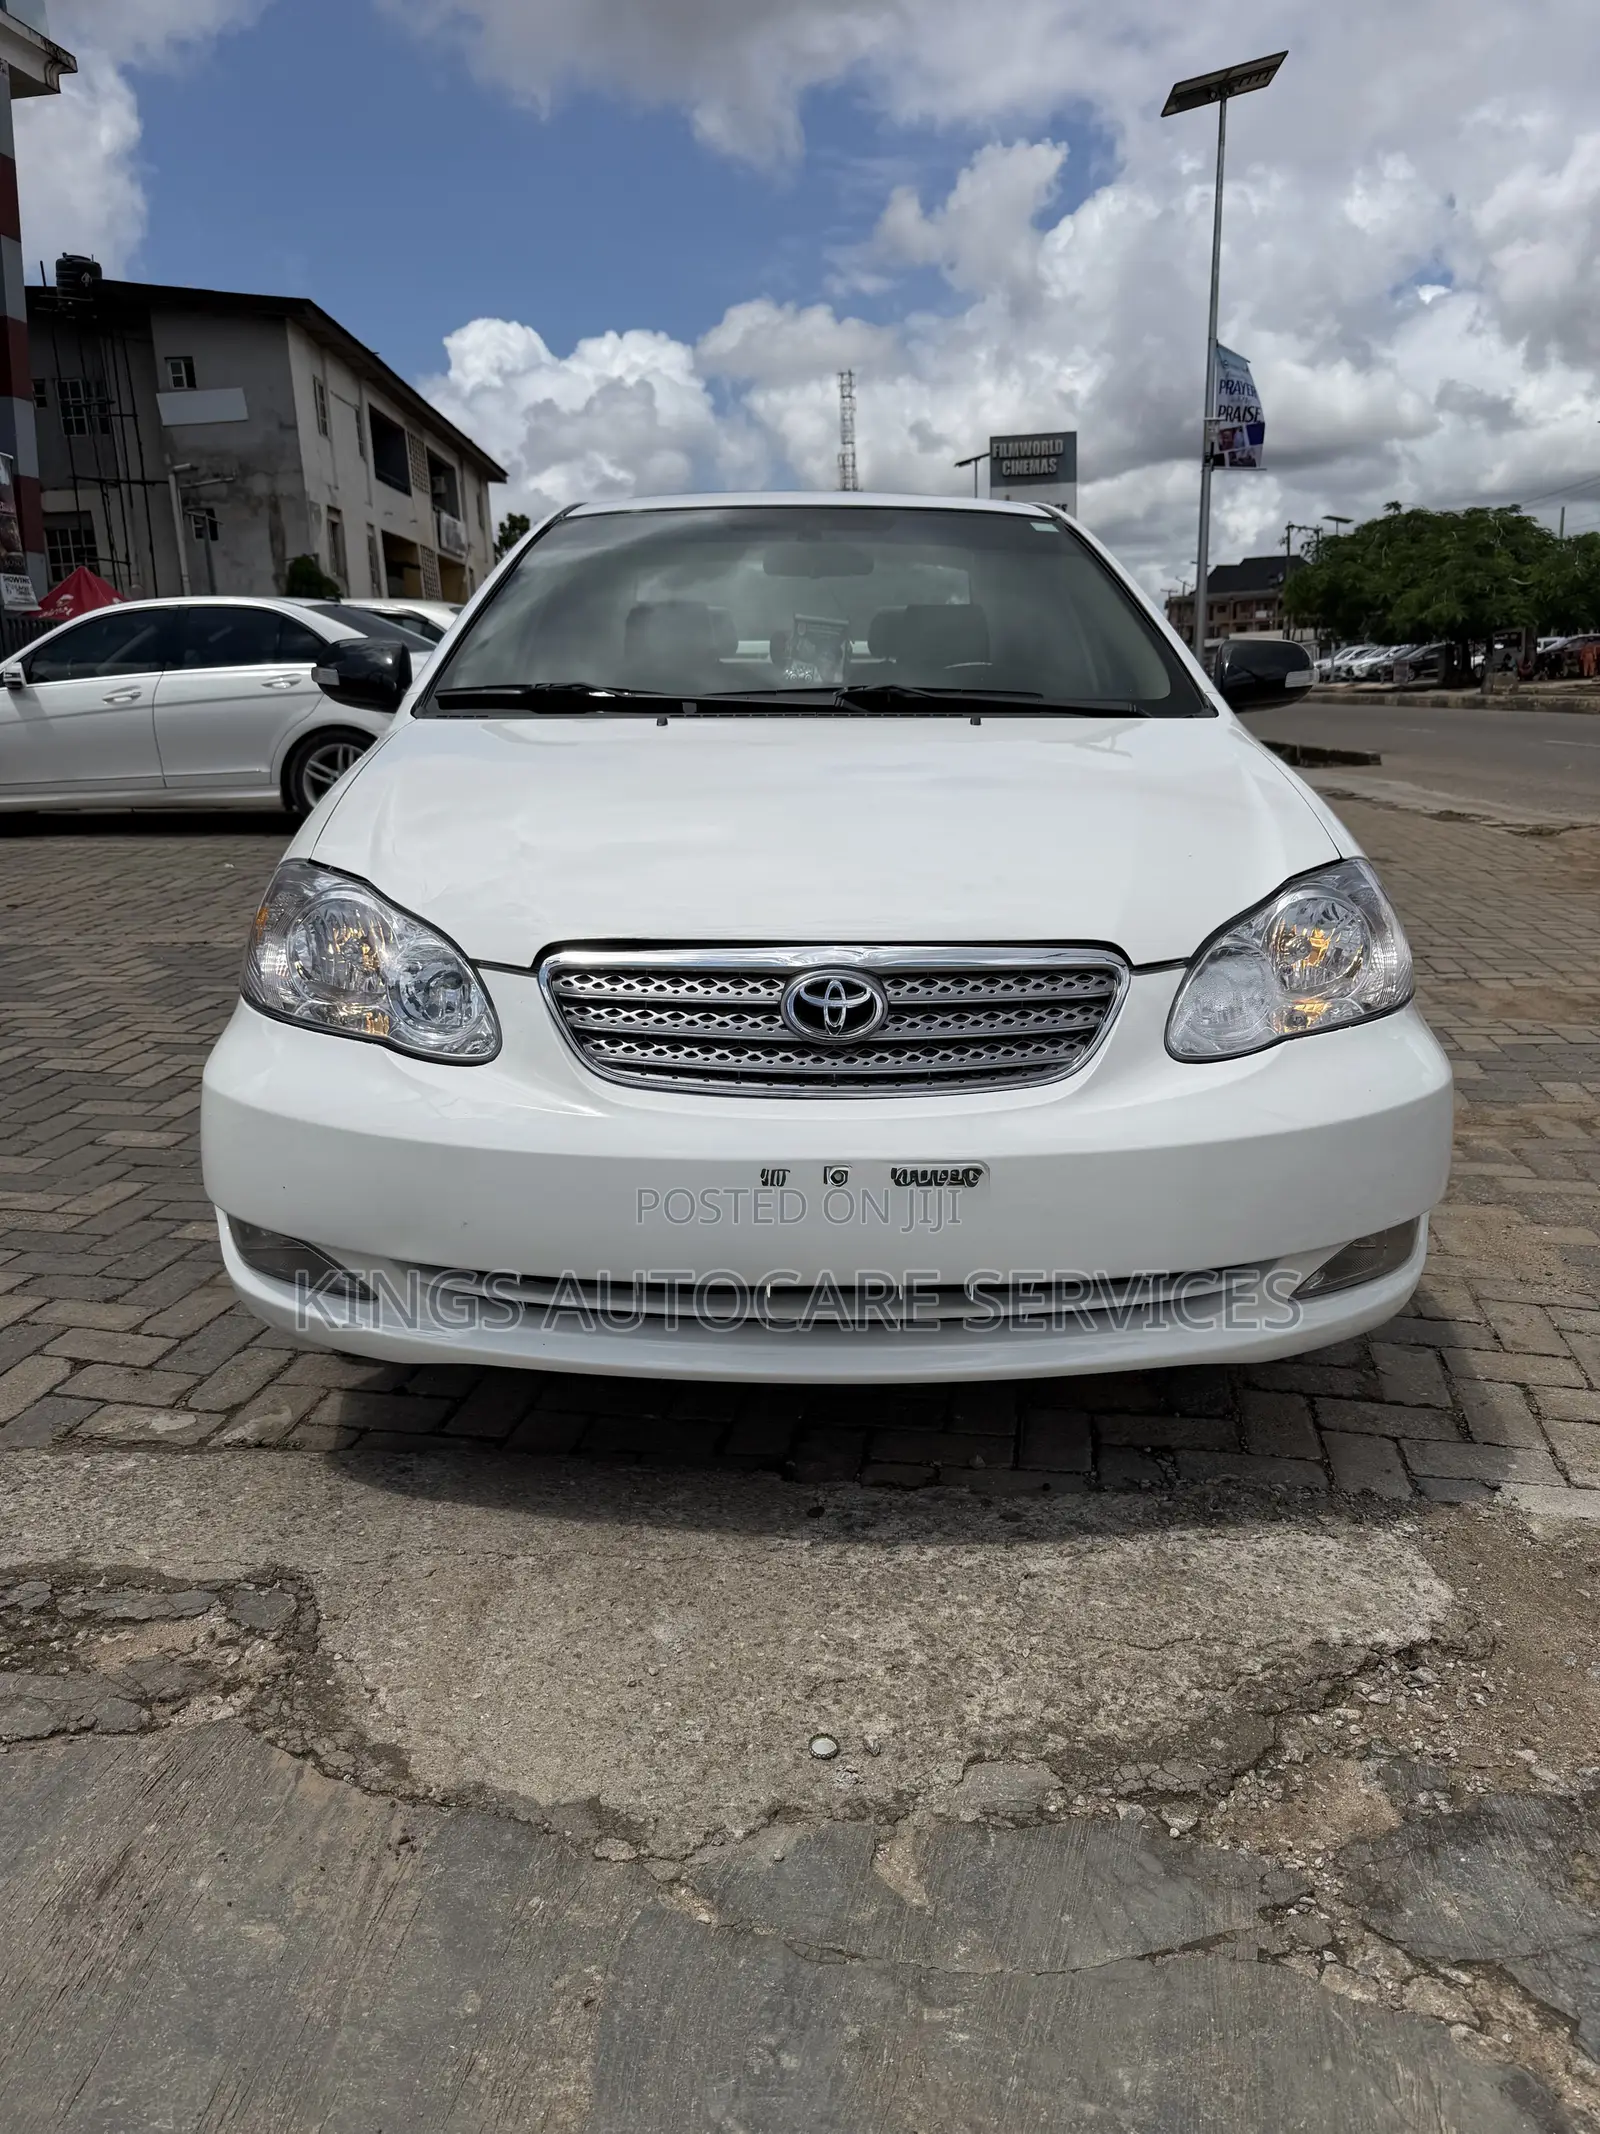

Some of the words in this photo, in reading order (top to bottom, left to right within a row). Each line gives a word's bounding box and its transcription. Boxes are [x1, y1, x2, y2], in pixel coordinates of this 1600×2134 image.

[1218, 405, 1262, 422] PRAISE
[992, 439, 1064, 459] FILMWORLD
[1002, 458, 1057, 476] CINEMAS
